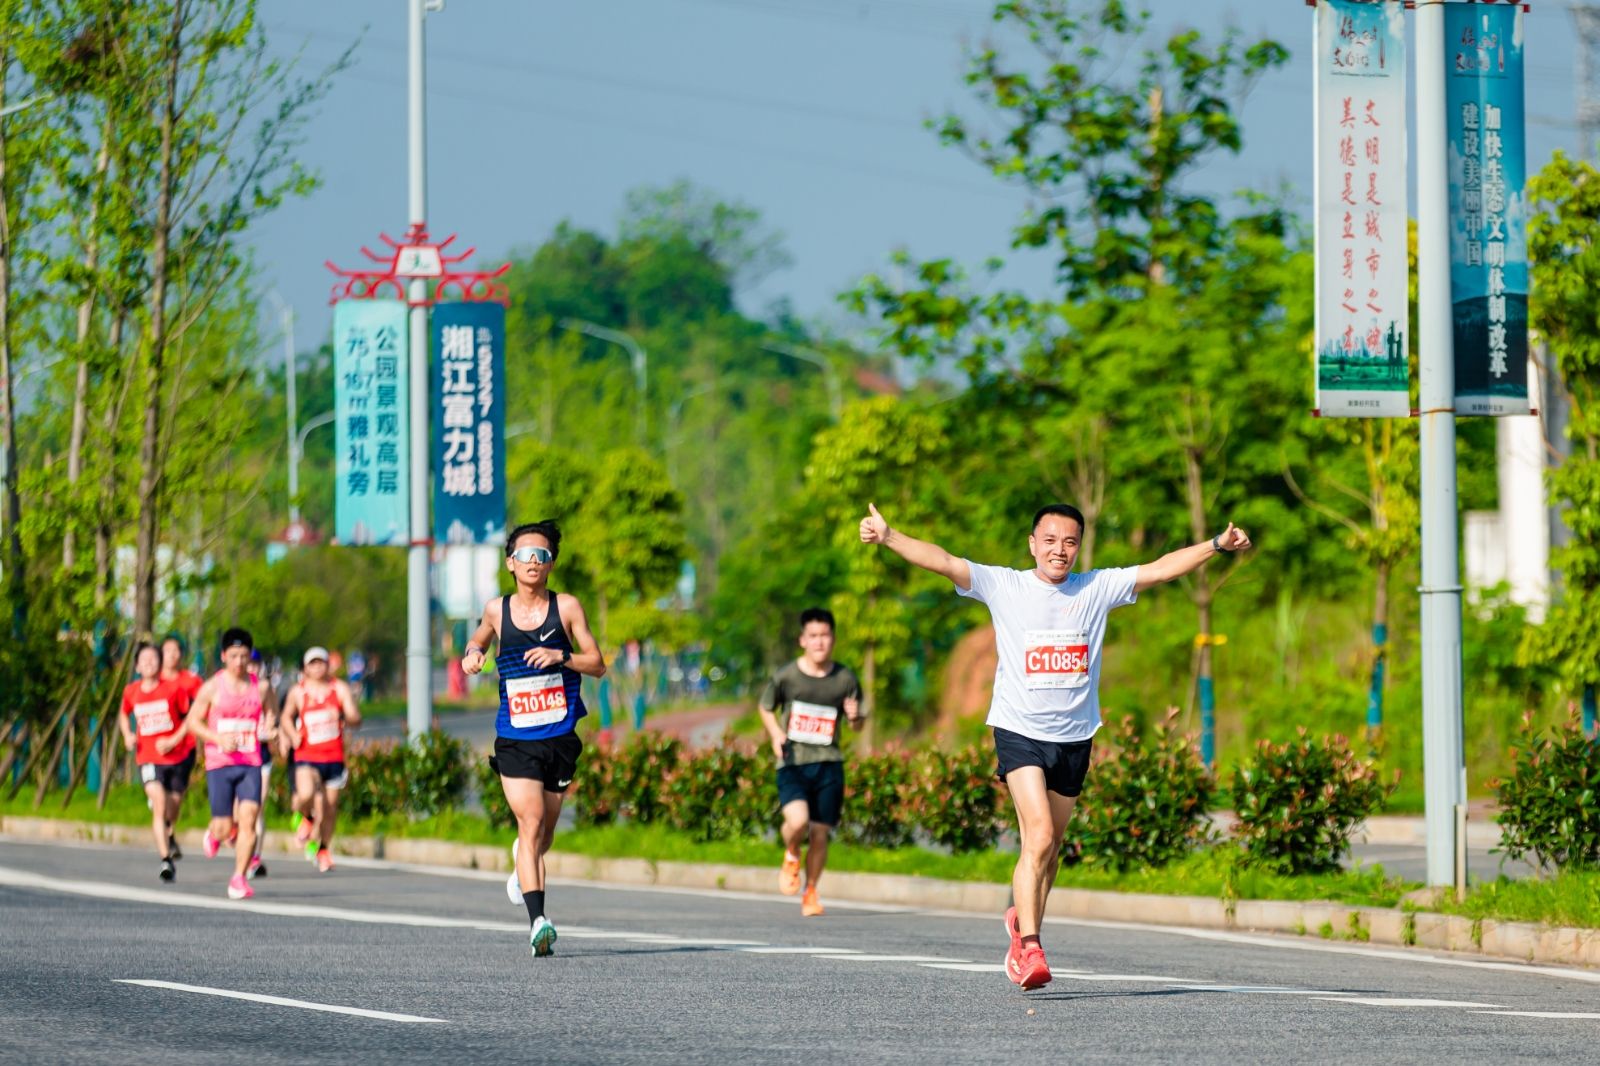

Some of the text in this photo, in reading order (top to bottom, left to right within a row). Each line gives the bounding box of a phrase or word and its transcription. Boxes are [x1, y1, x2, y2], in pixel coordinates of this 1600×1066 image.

[1339, 97, 1358, 355] 美德是立身之本
[1364, 99, 1383, 355] 文明是城市之魂
[1461, 102, 1483, 268] 建设美丽中国
[1484, 103, 1509, 379] 加快生态文明体制改革
[375, 326, 398, 495] 公园景观高层
[441, 325, 477, 496] 湘江富力城
[512, 692, 565, 713] C10148
[1028, 651, 1088, 671] C10854
